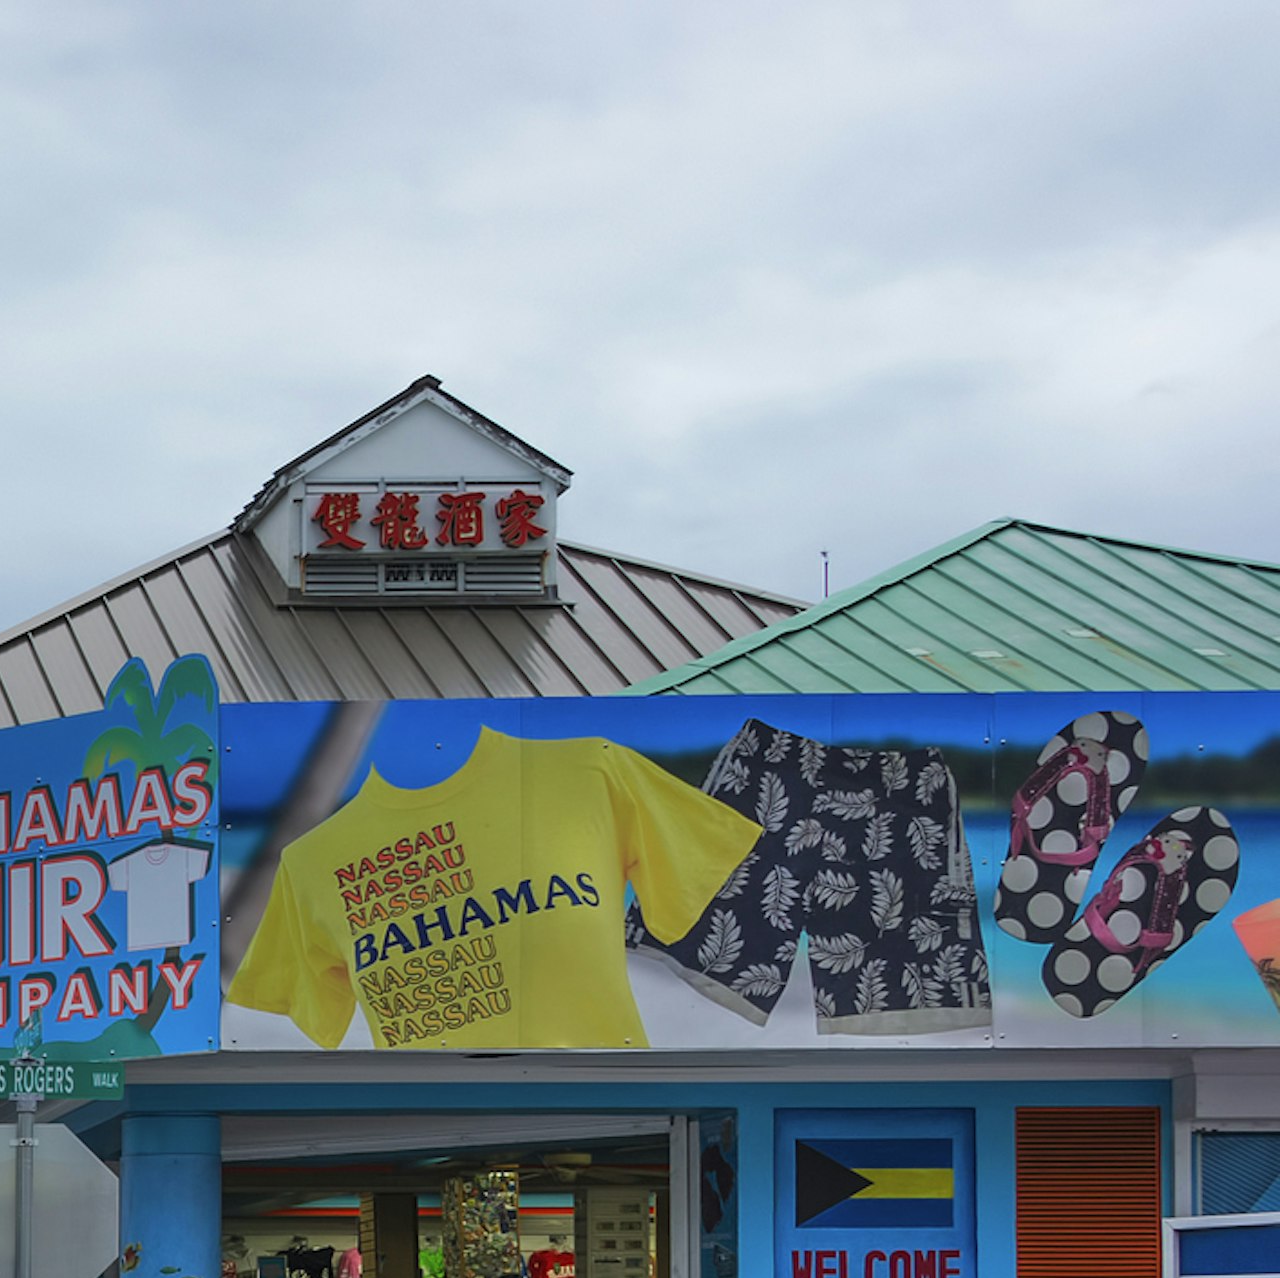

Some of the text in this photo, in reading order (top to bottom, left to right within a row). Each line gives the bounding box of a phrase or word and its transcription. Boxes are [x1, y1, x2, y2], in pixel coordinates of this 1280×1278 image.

[311, 488, 548, 549] 雙龍酒家
[333, 820, 457, 889] NASSAU
[339, 844, 467, 912] NASSAU
[346, 868, 476, 935] NASSAU
[353, 872, 600, 973] BAHAMAS
[358, 934, 498, 1000] NASSAU
[369, 962, 505, 1024] NASSAU
[380, 988, 512, 1048] NASSAU
[13, 1065, 75, 1094] ROGERS
[92, 1072, 120, 1088] WALK
